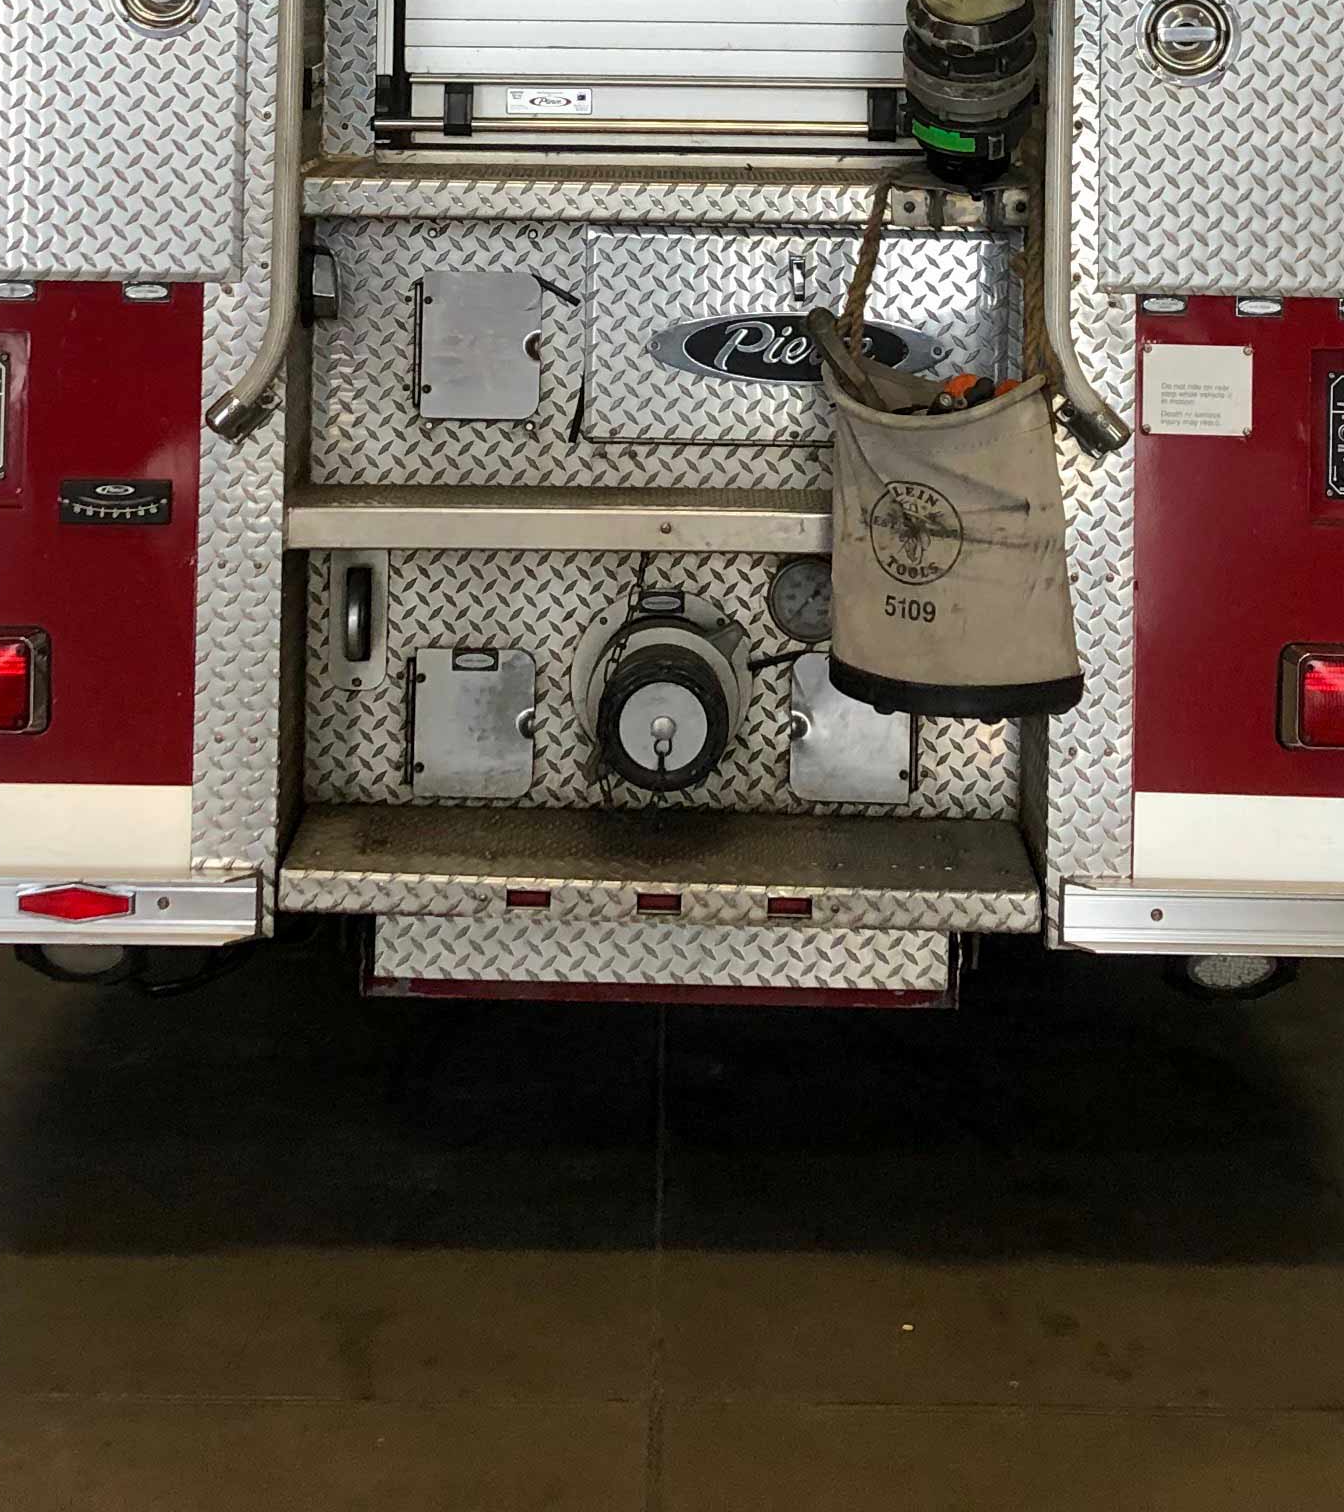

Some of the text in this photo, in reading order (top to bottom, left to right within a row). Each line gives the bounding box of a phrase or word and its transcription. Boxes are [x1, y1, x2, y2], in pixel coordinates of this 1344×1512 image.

[892, 486, 939, 507] LEIN
[886, 555, 940, 579] TOOLS
[884, 594, 937, 623] 5109
